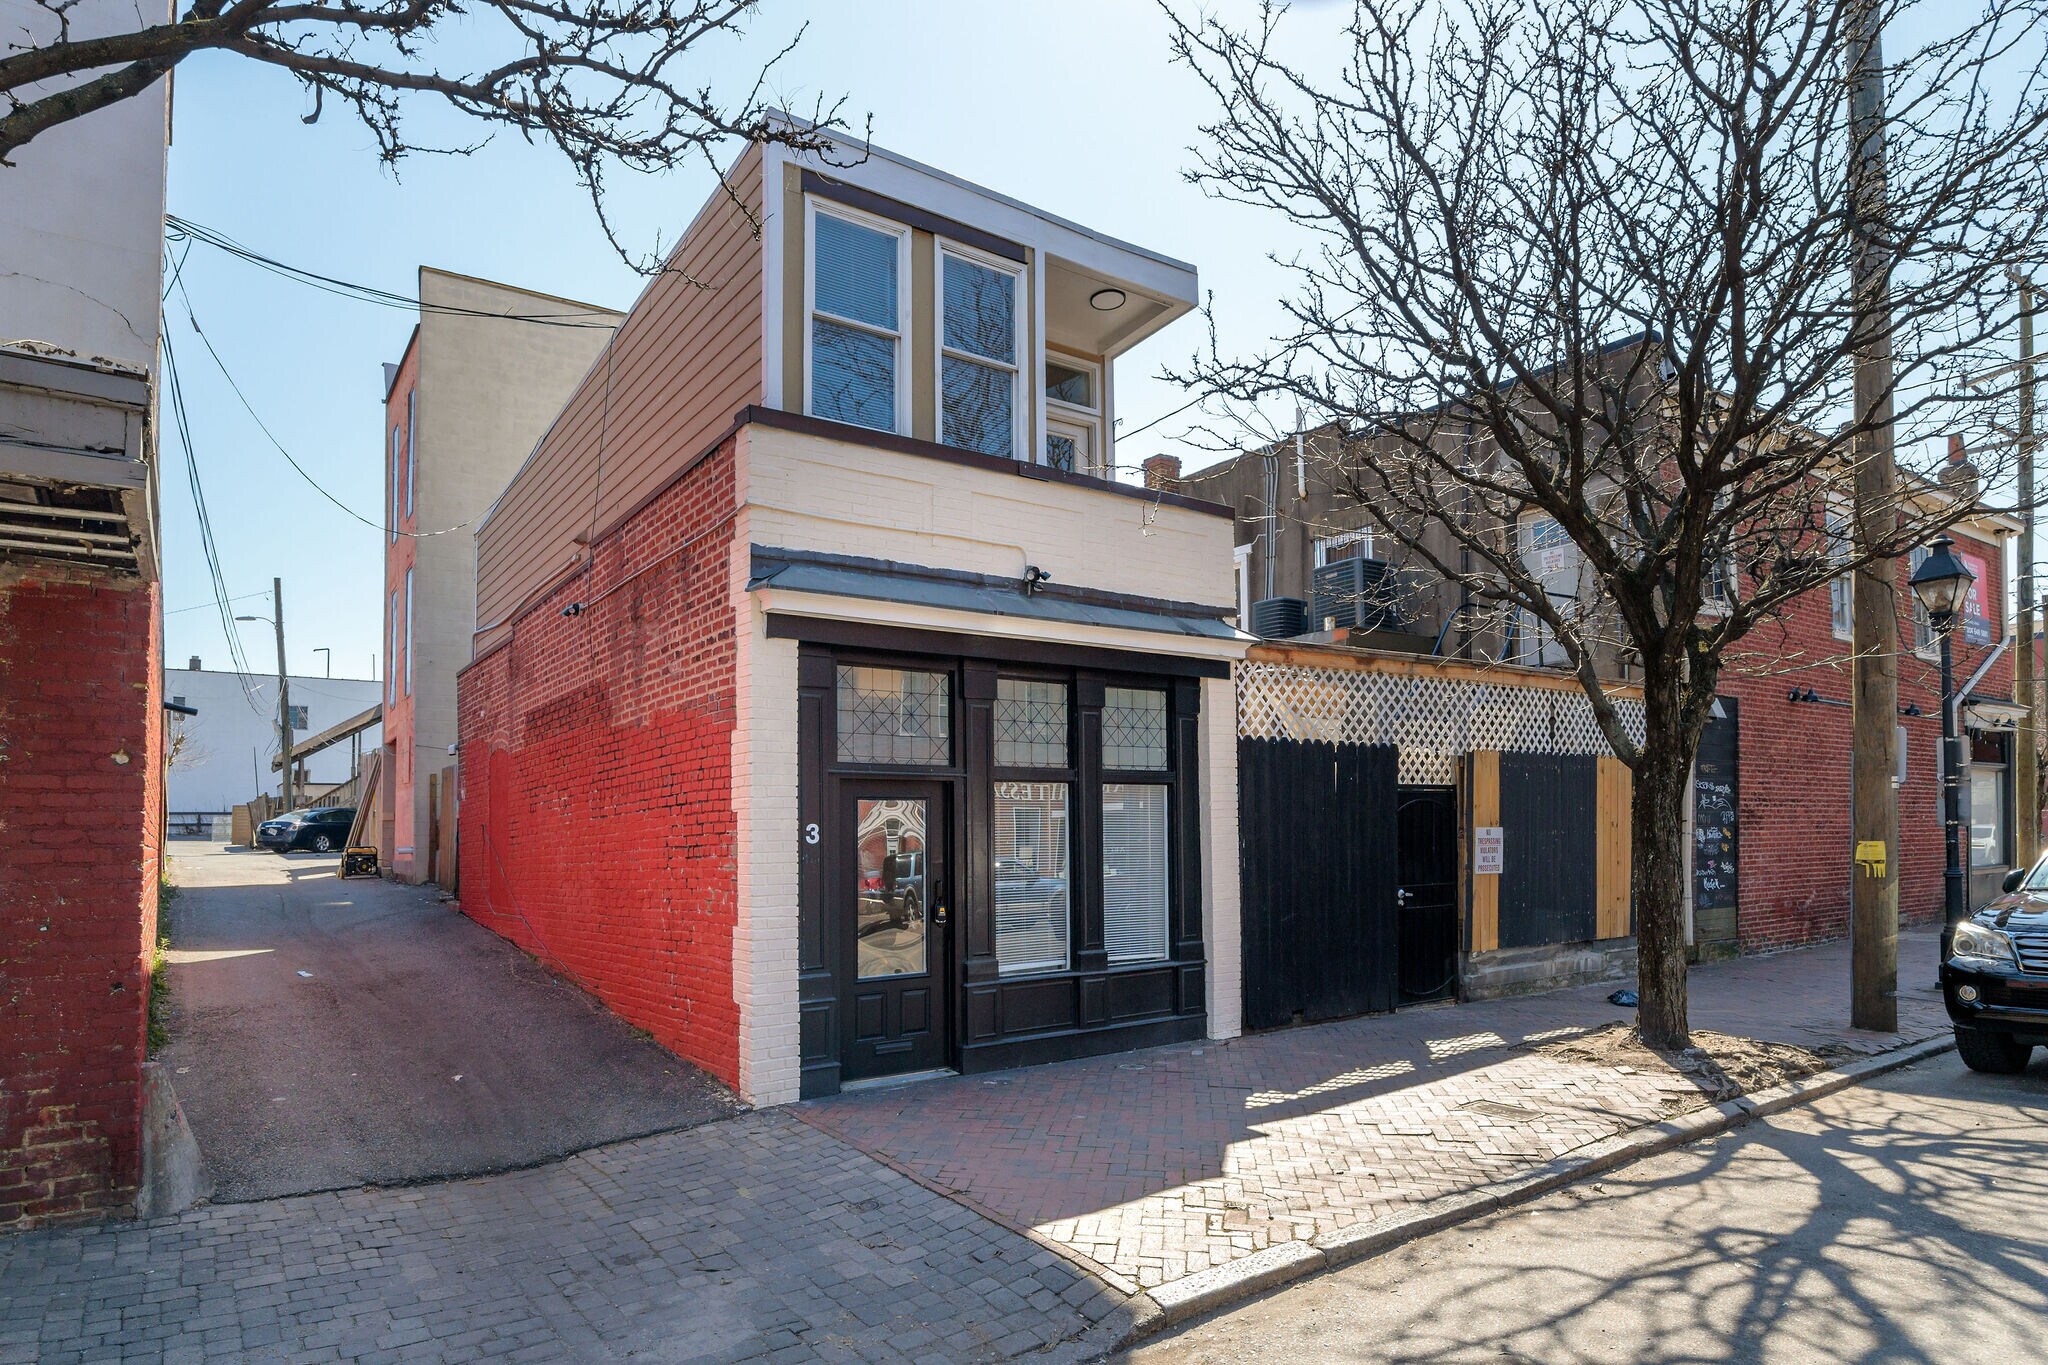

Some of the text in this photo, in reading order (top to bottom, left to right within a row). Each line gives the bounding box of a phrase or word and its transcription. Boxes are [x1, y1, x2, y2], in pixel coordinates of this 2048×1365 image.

[1968, 588, 1977, 600] OR
[1965, 601, 1981, 616] SALE
[805, 823, 820, 844] 3
[1478, 837, 1502, 845] TRESPASSING
[1482, 855, 1496, 863] WILL BE
[1478, 864, 1500, 872] PROSECUTED
